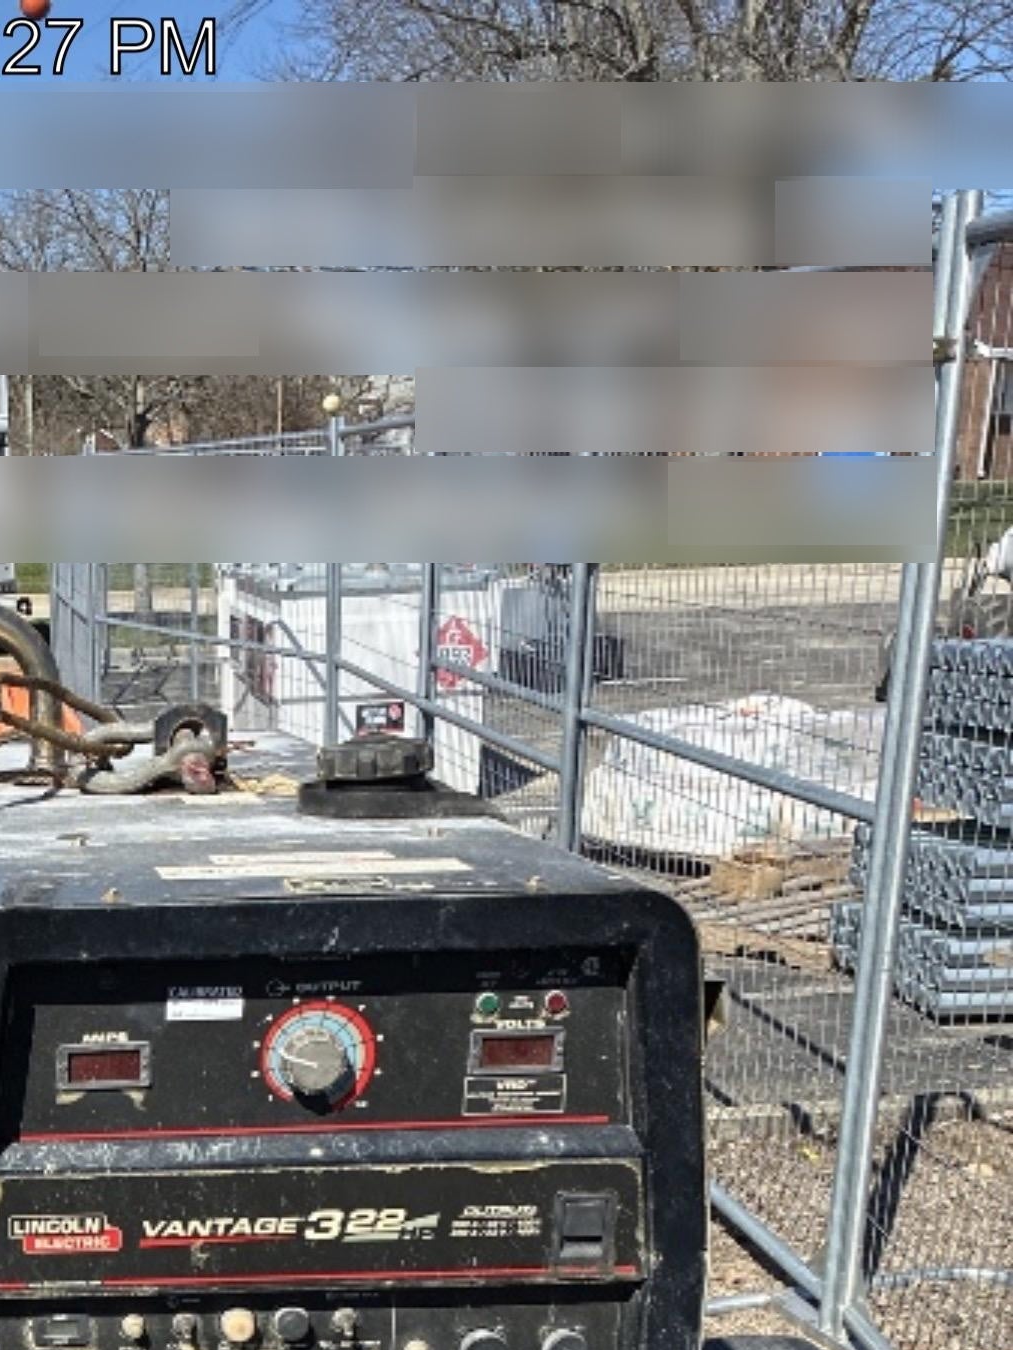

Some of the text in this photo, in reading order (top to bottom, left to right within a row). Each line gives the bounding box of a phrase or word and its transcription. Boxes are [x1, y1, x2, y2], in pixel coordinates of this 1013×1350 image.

[12, 1216, 101, 1236] LINCOLN
[142, 1216, 300, 1238] VANTAGE
[304, 1207, 408, 1241] 322
[33, 1234, 112, 1250] ELECTRIC
